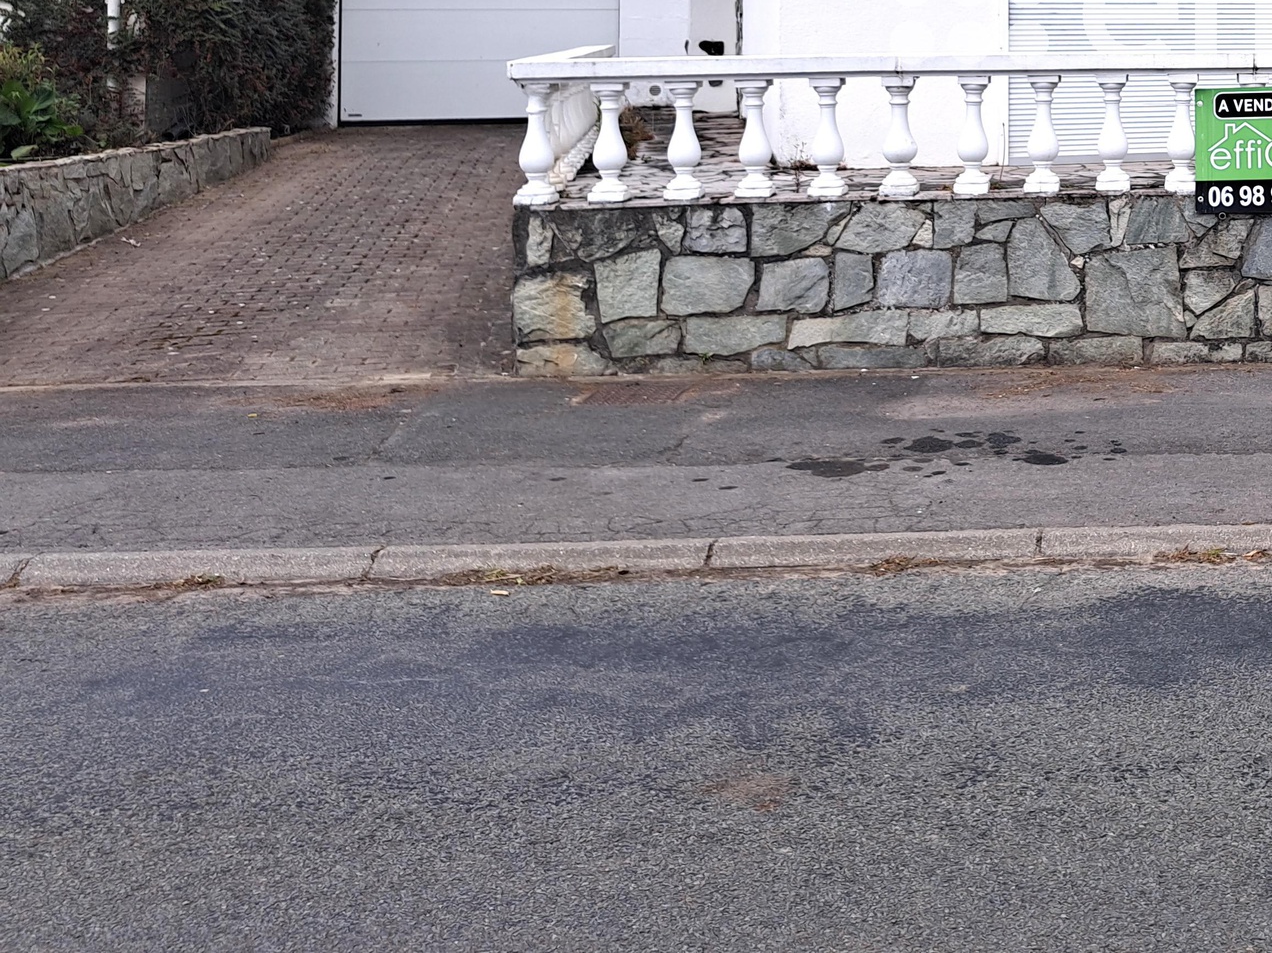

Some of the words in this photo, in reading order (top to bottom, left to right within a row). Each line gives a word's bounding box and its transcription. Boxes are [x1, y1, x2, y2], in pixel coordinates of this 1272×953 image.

[1218, 99, 1229, 113] A
[1208, 185, 1234, 207] 06
[1239, 185, 1265, 206] 98
